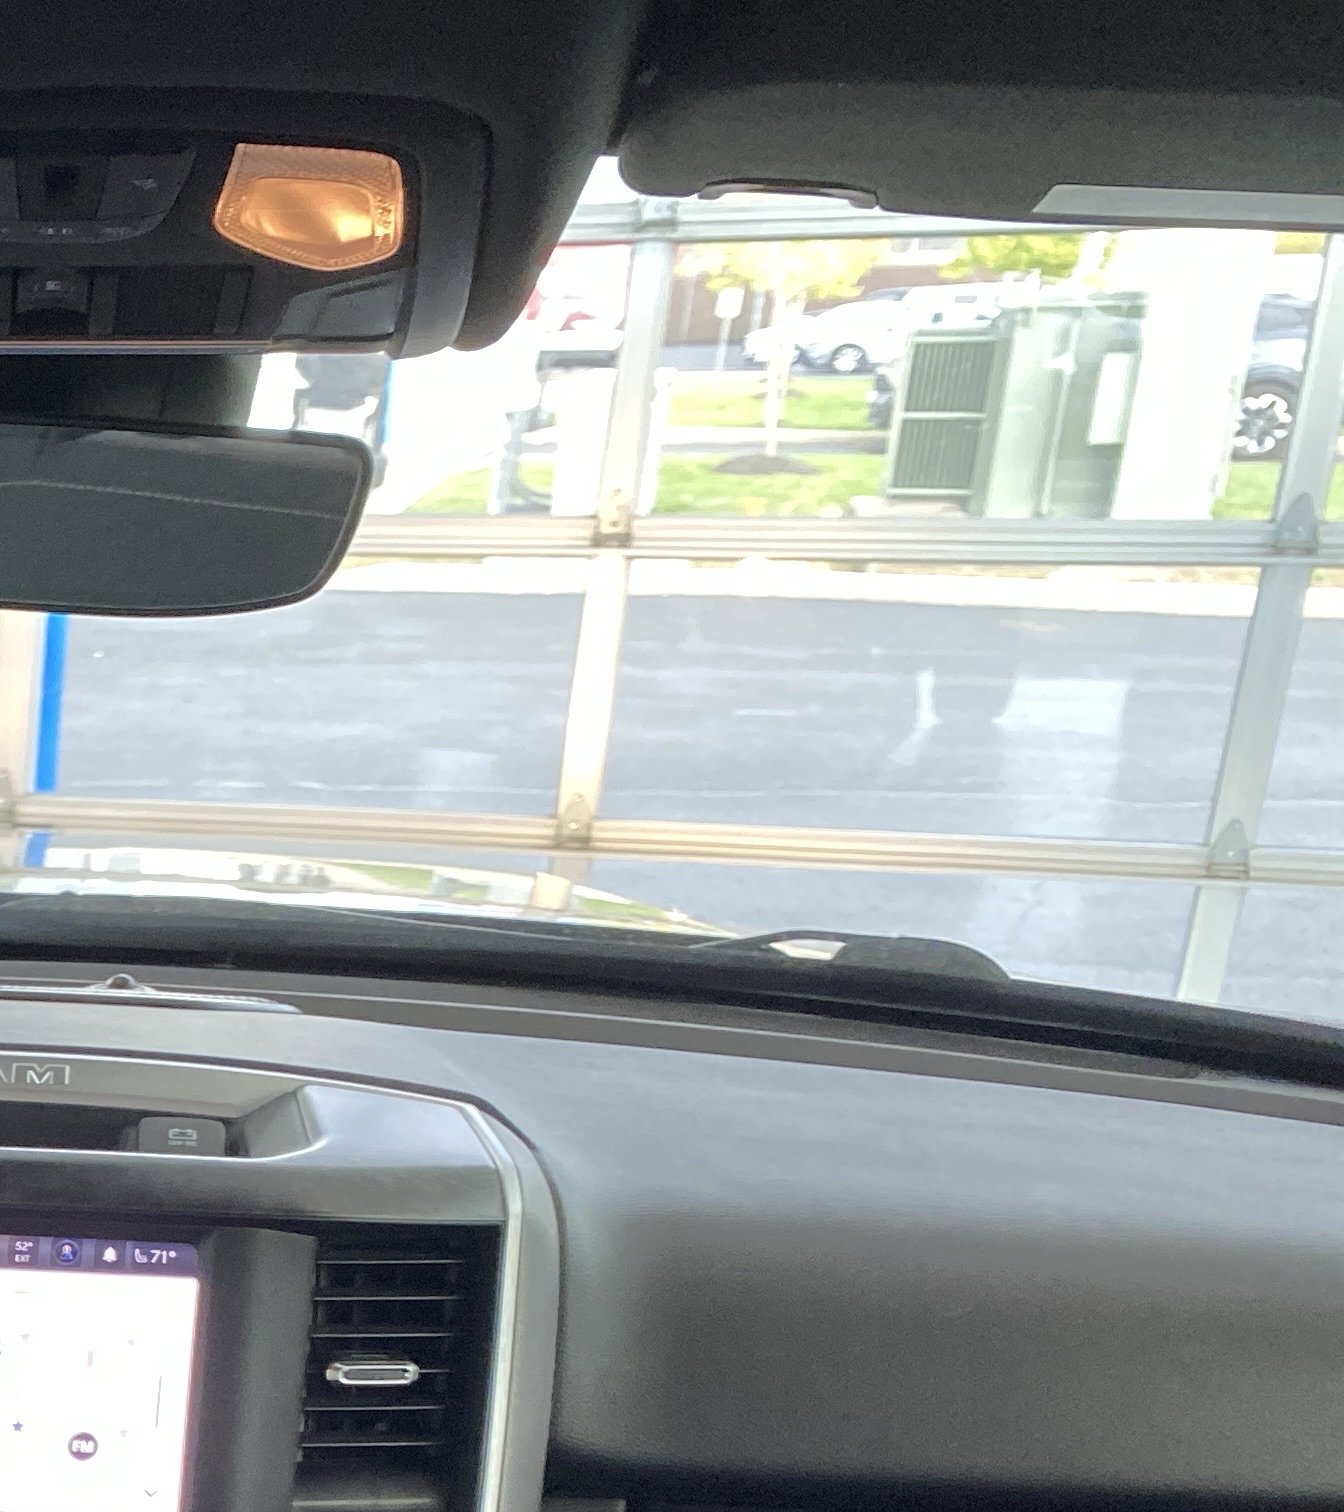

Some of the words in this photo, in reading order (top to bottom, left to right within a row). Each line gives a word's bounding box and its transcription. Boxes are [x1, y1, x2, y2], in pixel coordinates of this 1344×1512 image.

[15, 1255, 31, 1263] EXT
[151, 1250, 176, 1264] 71°
[71, 1440, 95, 1453] FM
